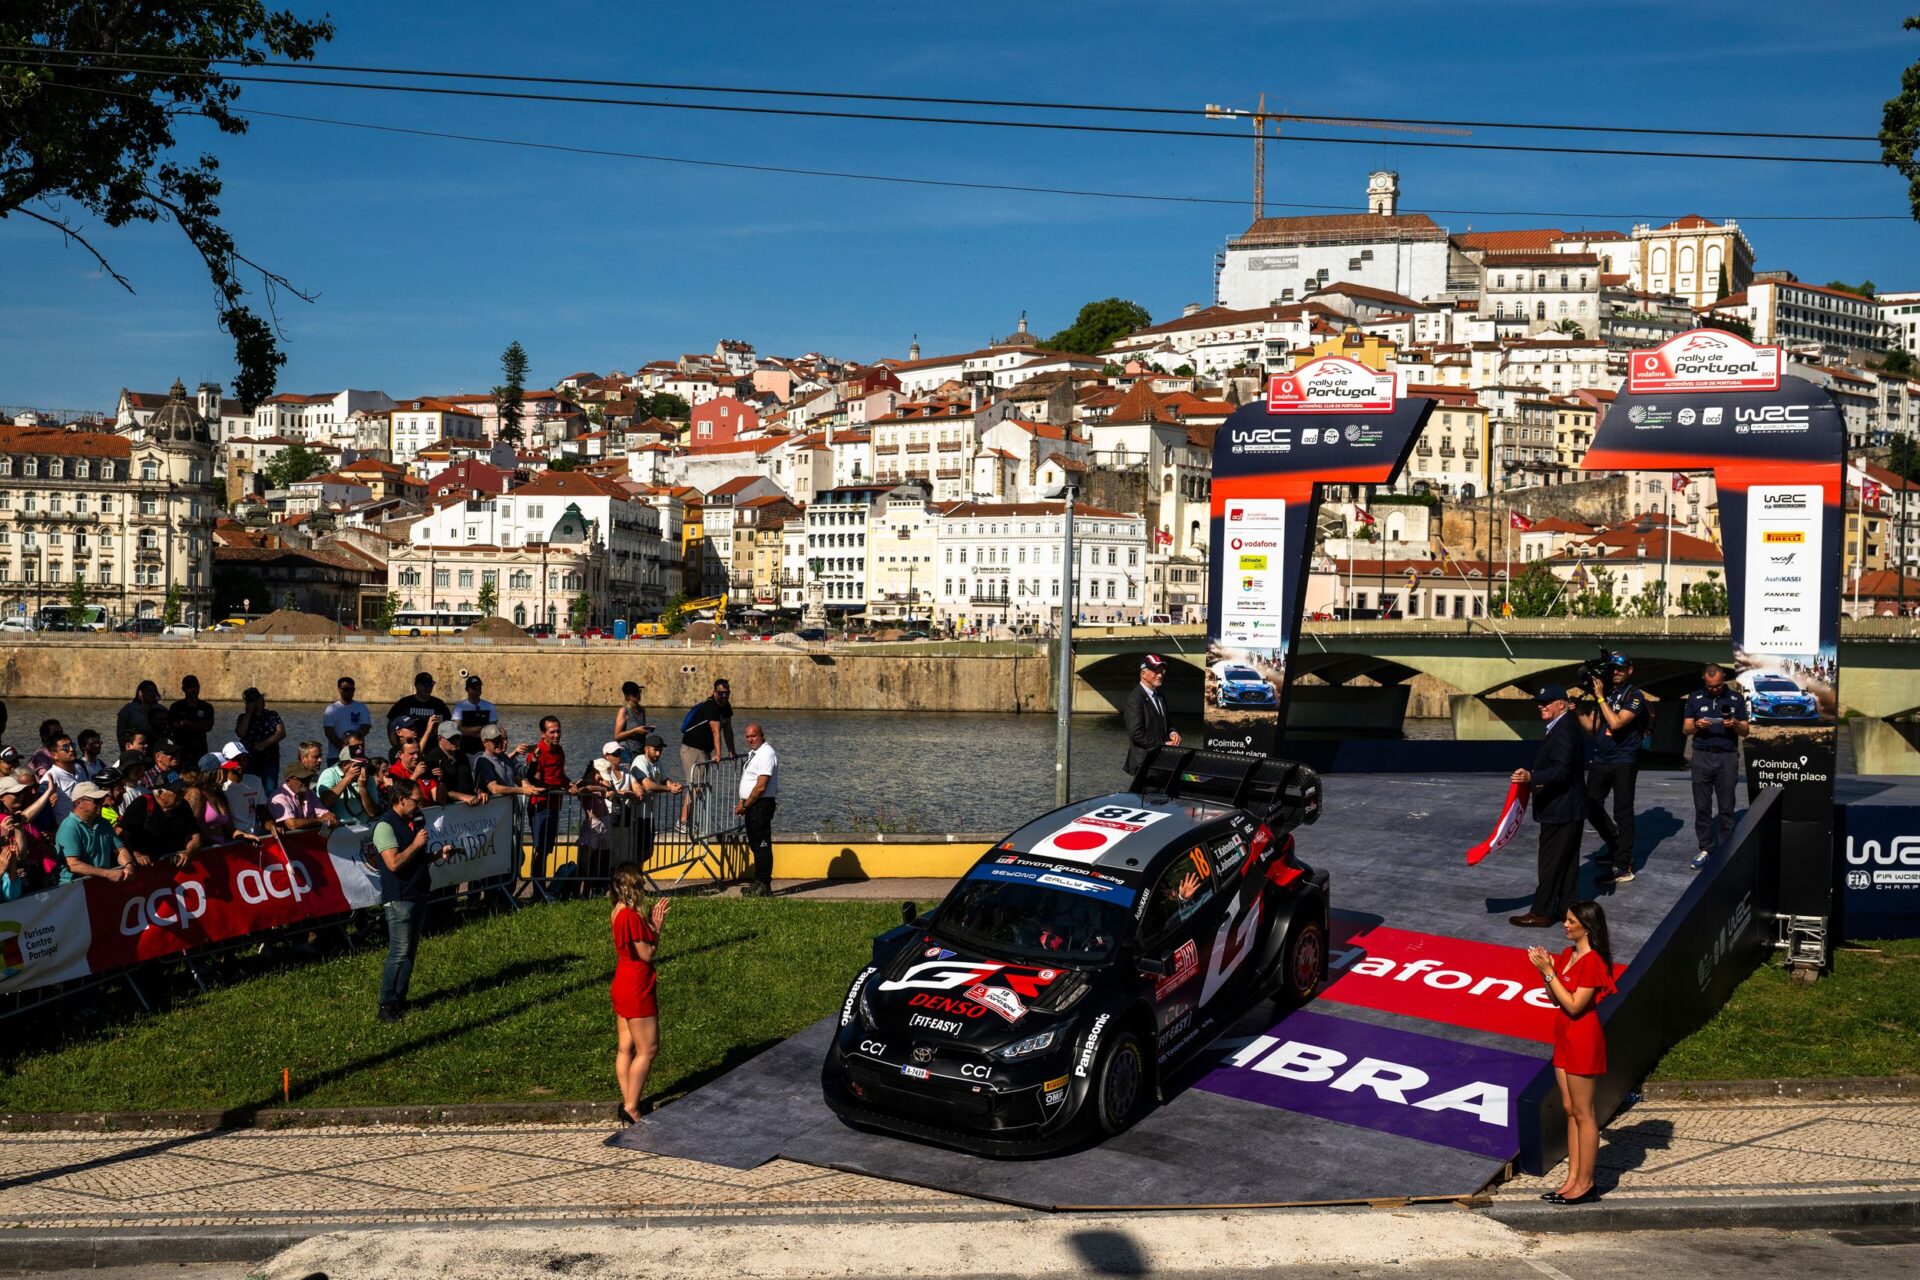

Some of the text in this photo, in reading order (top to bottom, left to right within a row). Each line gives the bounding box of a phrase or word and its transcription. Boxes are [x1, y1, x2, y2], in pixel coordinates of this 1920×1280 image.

[1677, 354, 1705, 362] rally
[1675, 362, 1758, 374] Portugal
[1306, 387, 1377, 398] Portugal
[1705, 416, 1720, 424] acp
[1735, 405, 1809, 422] WRC
[1232, 429, 1291, 442] WRC
[1764, 494, 1806, 503] WRC
[1767, 533, 1801, 542] PIRELLI
[410, 708, 435, 716] PUMA
[1208, 738, 1246, 748] #Coimbra,
[1752, 759, 1800, 770] #Coimbra,
[1759, 771, 1827, 782] the right place
[1095, 808, 1152, 823] 18
[1846, 835, 1920, 865] WR
[1188, 847, 1211, 880] 18
[991, 870, 1082, 888] BEYOND RALLY
[1016, 859, 1053, 868] TOYOTA
[1054, 864, 1090, 875] GAZOO
[1090, 871, 1125, 885] Racing
[237, 859, 312, 905] acp
[1848, 874, 1869, 886] FIA
[119, 880, 206, 936] acp
[24, 925, 55, 940] Turismo
[26, 937, 52, 950] Centro
[29, 943, 58, 960] Portugal
[878, 959, 1072, 998] GR
[841, 966, 877, 1027] Panasonic
[986, 994, 1017, 1013] Portugal
[908, 993, 987, 1018] DENSO
[1075, 1013, 1111, 1077] Panasonic
[1046, 1090, 1063, 1104] OMP
